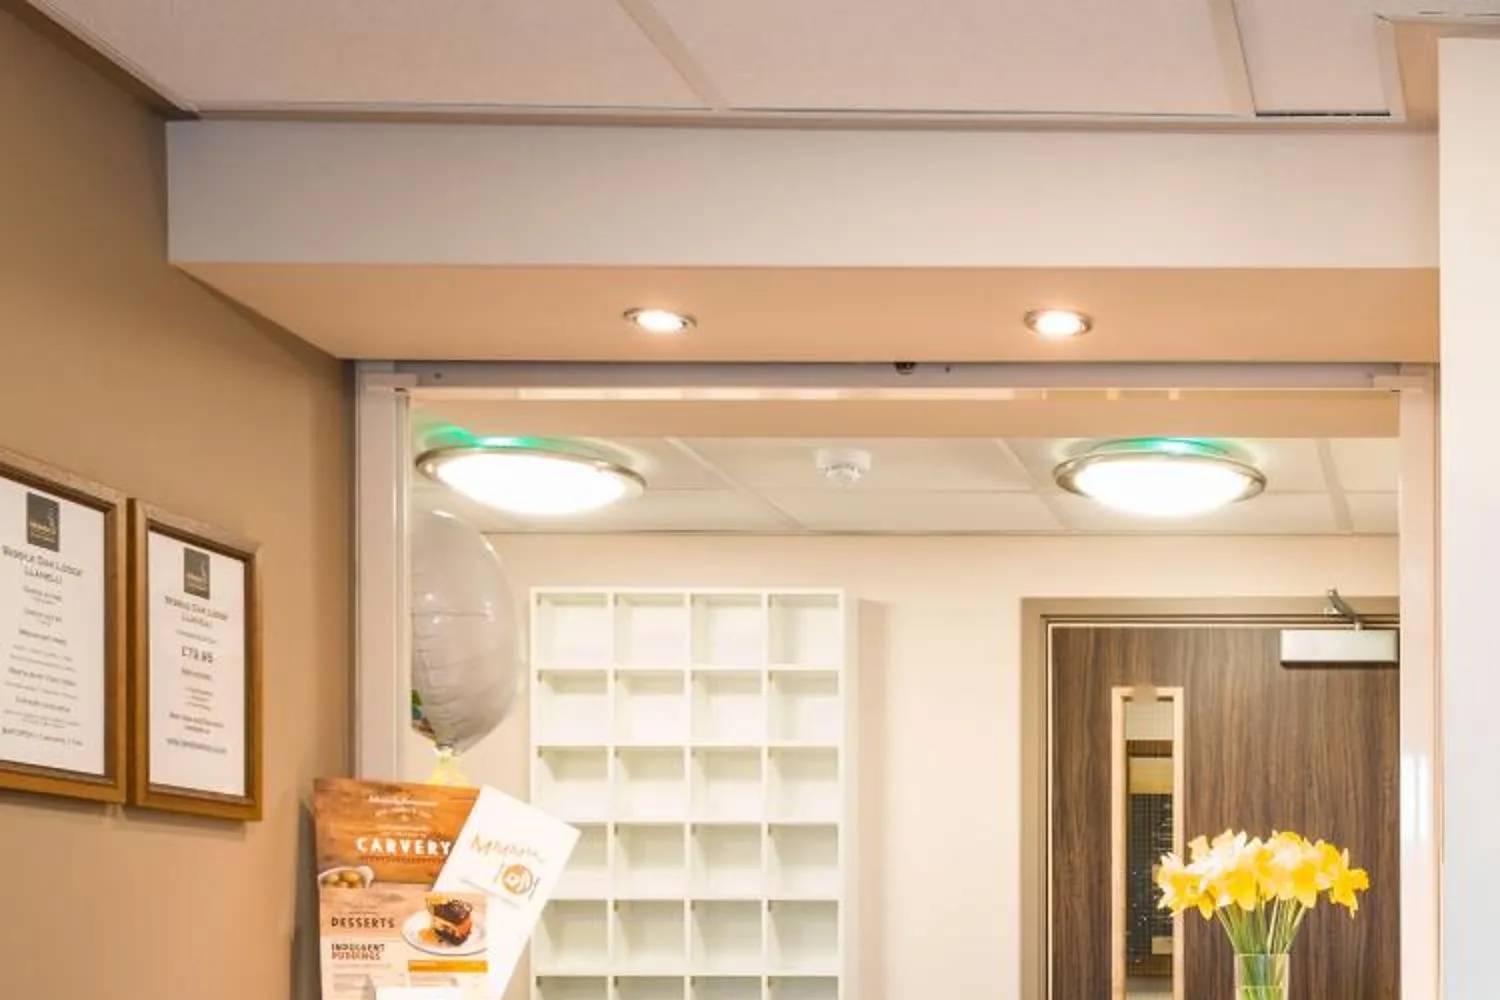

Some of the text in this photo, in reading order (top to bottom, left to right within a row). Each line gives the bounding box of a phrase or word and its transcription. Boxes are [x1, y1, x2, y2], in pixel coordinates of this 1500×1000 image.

[356, 837, 451, 856] CARVERY
[331, 917, 395, 928] DESSERTS
[331, 943, 385, 953] INDULGENT
[331, 951, 381, 961] PUDDINGS
